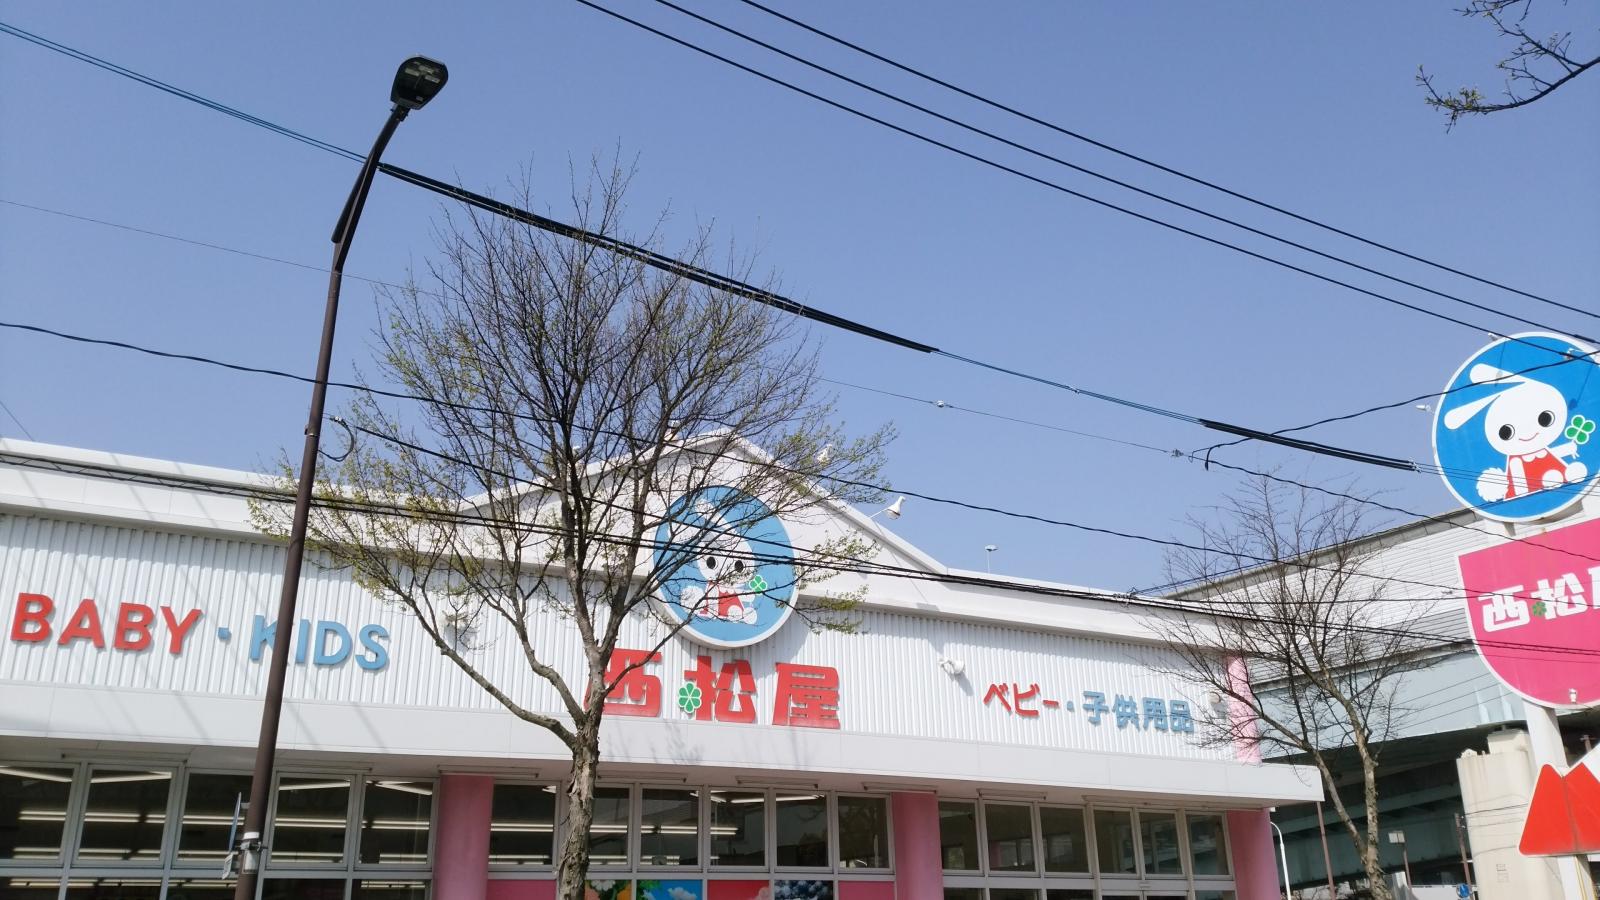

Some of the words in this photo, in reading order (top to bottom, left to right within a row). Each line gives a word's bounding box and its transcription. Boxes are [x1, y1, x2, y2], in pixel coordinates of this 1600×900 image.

[10, 592, 203, 655] BABY
[1478, 565, 1600, 633] 西松
[583, 647, 840, 730] 西松屋
